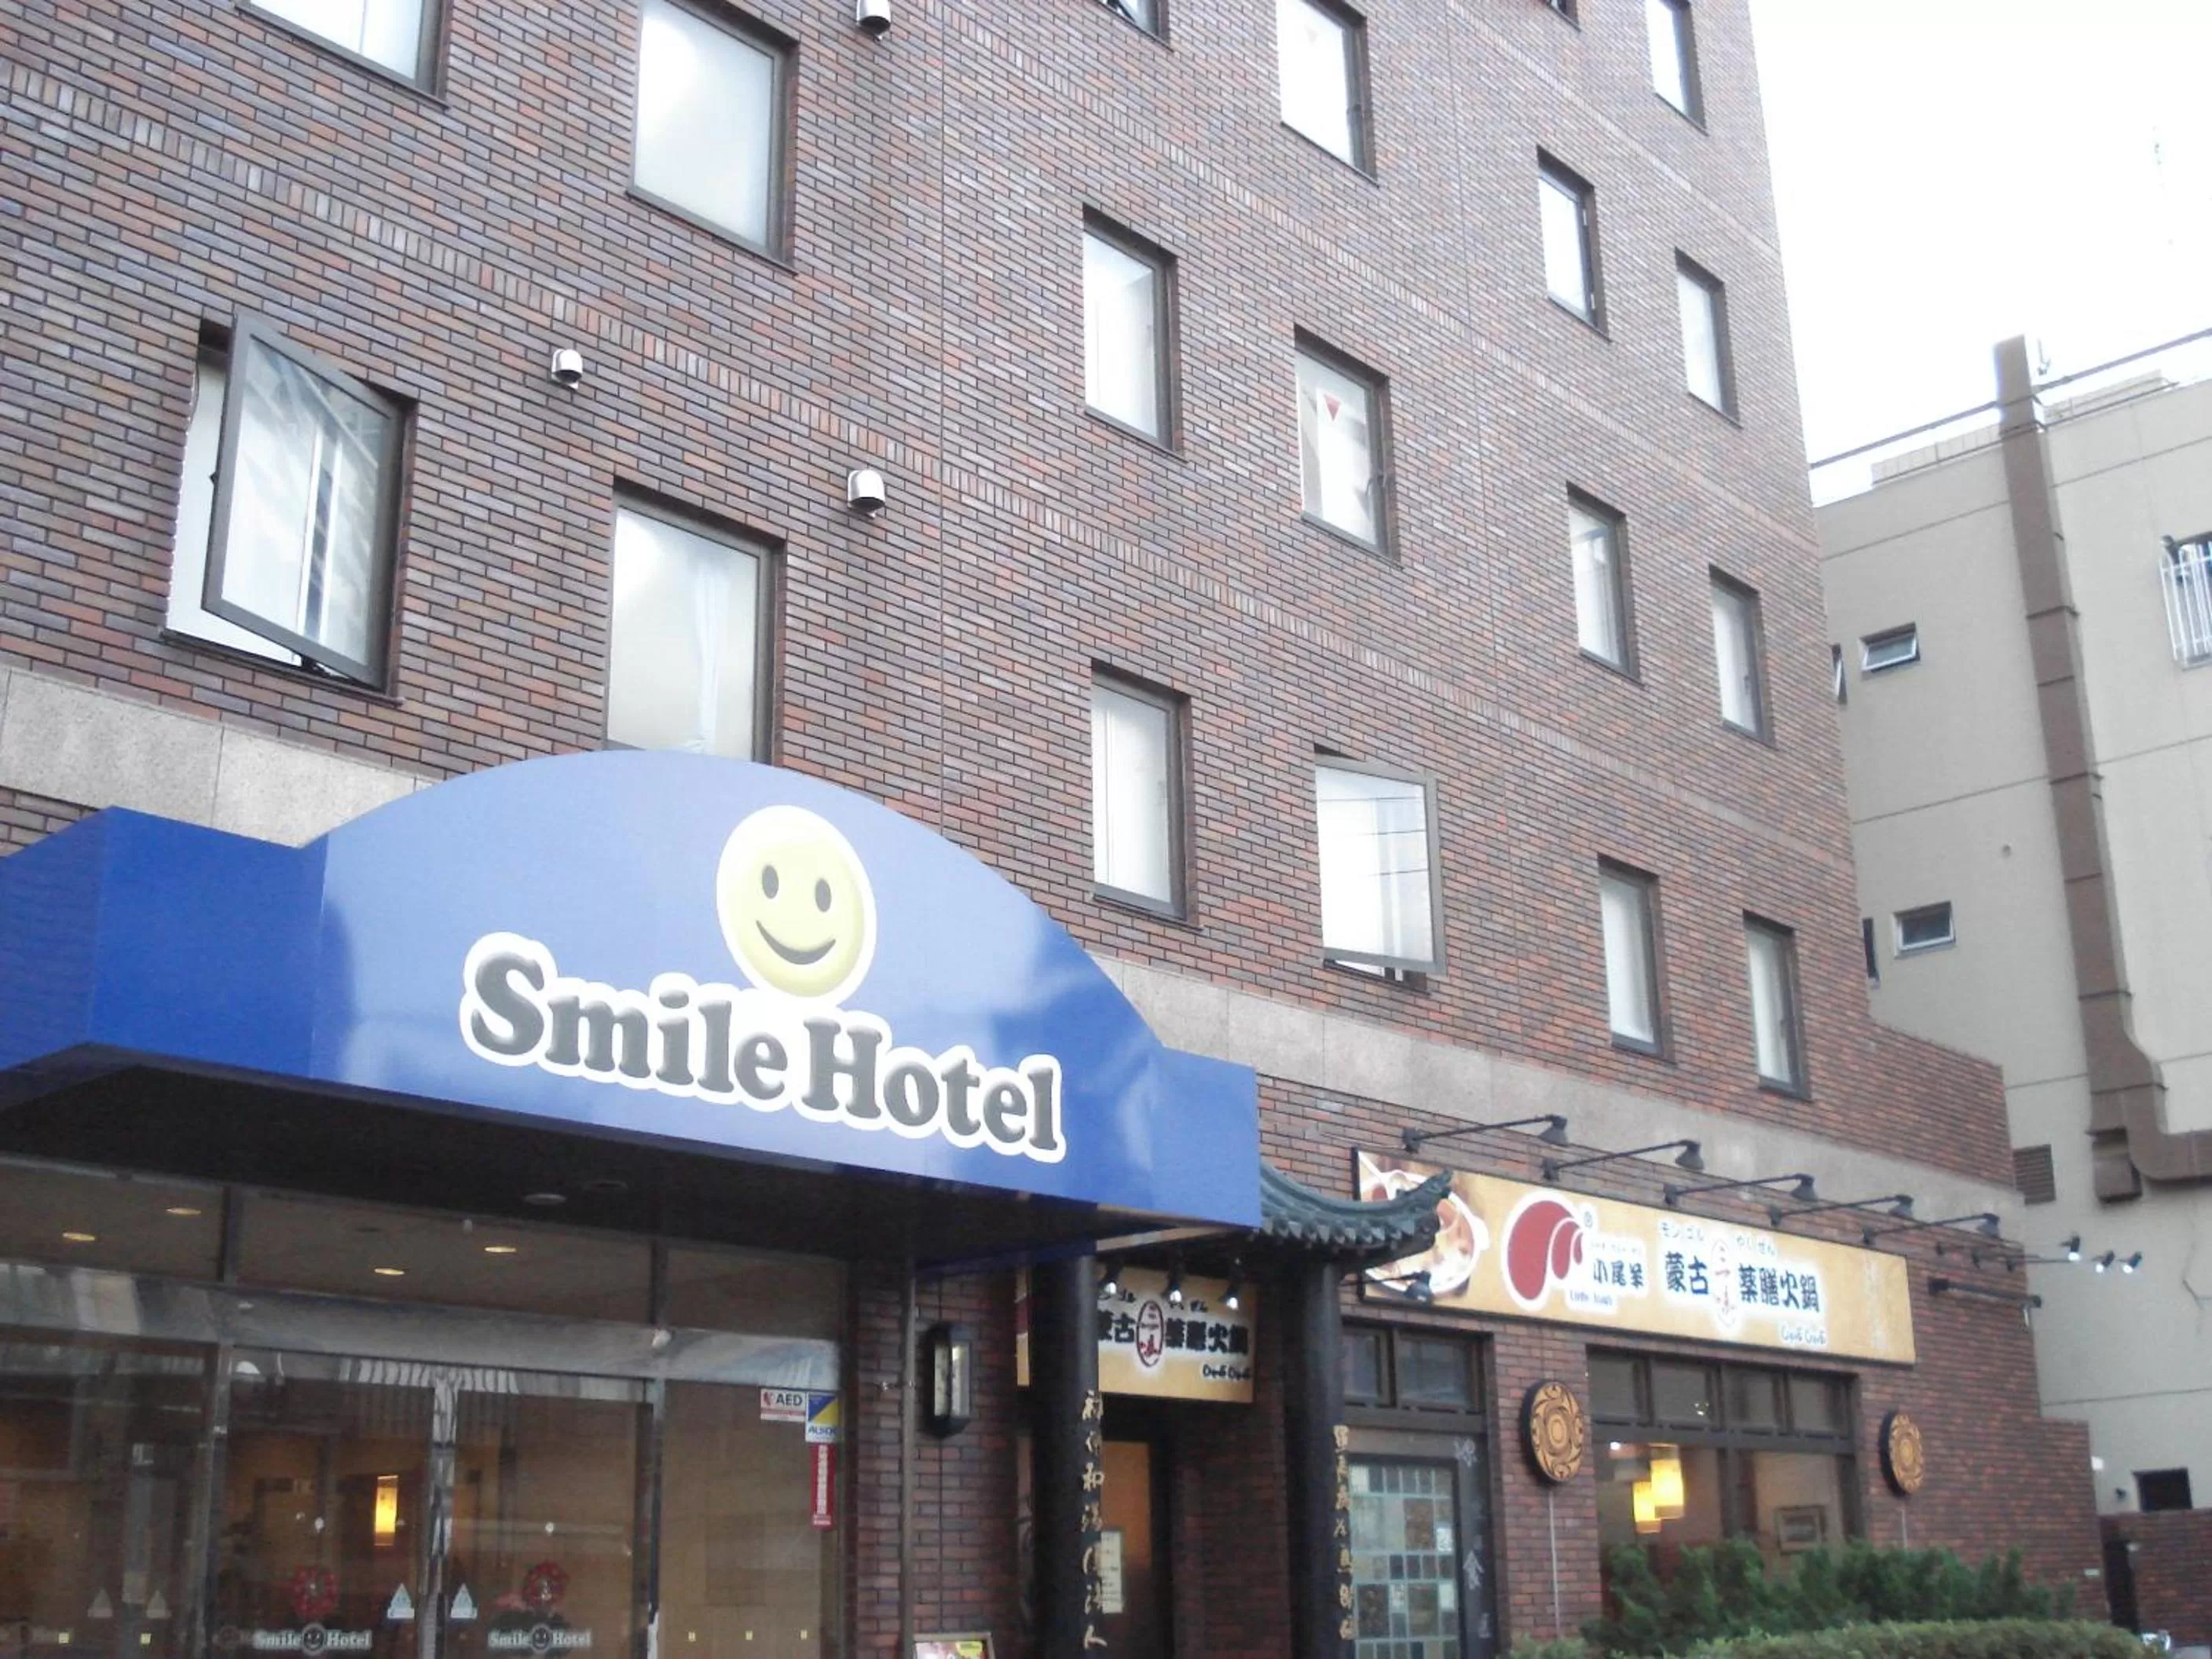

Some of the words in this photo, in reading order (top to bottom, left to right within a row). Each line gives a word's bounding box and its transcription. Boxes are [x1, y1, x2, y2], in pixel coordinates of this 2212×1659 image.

[470, 947, 786, 1101] Smile
[800, 1014, 1060, 1152] Hotel
[1664, 1250, 1710, 1296] 蒙古
[775, 1393, 803, 1406] AED
[254, 1628, 301, 1649] Smile
[326, 1628, 372, 1648] Hotel
[489, 1628, 531, 1648] Smile
[552, 1628, 593, 1647] Hotel
